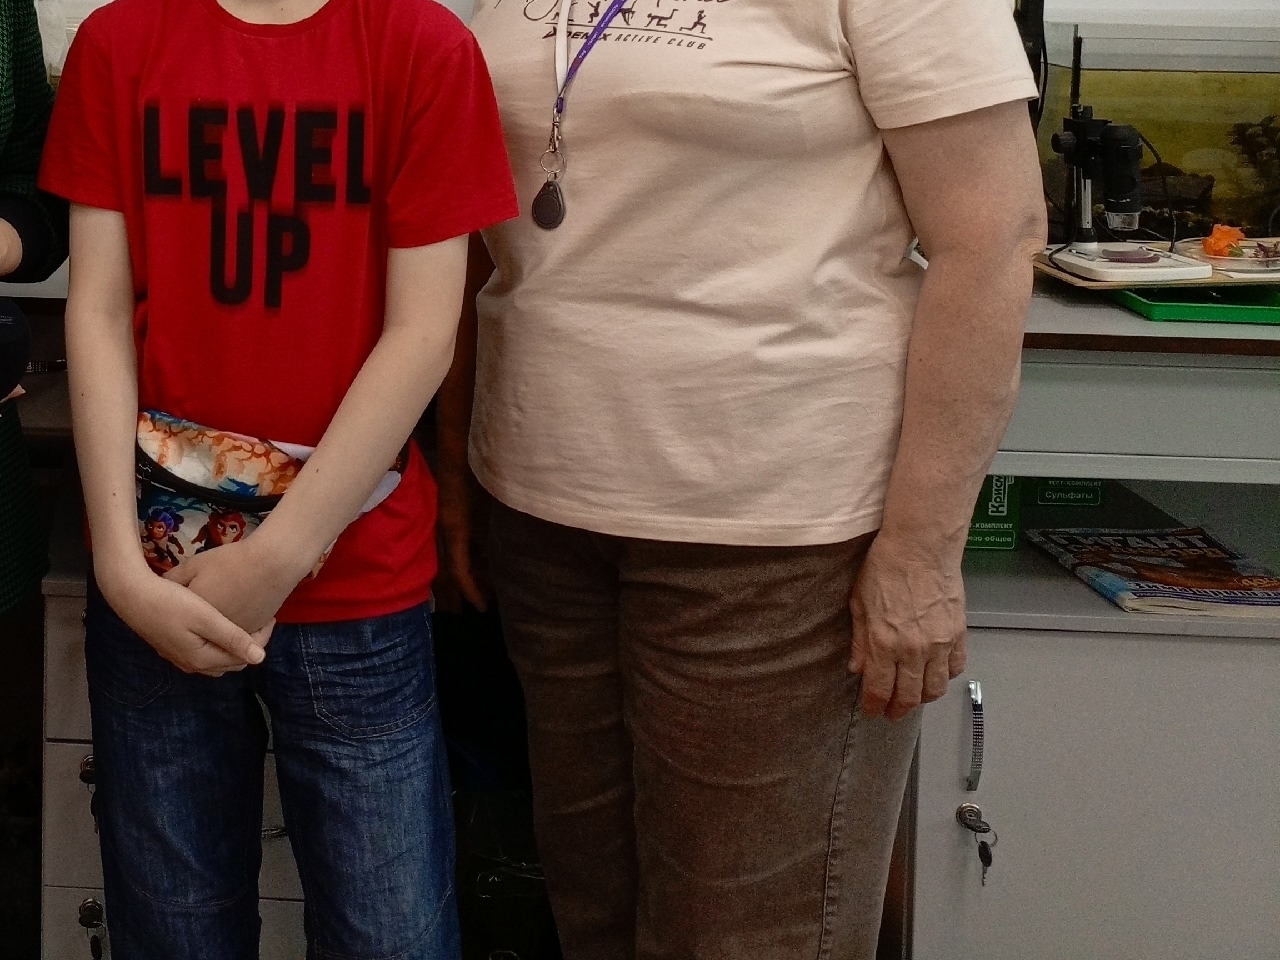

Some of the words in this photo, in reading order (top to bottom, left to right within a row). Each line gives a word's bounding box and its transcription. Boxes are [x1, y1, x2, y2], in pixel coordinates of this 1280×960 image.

[614, 33, 662, 44] ACTIVE
[667, 37, 707, 50] CLUB
[143, 105, 371, 205] LEVEL
[210, 208, 312, 310] UP
[1045, 490, 1094, 500] Сульфаты
[984, 534, 1012, 543] общее
[1048, 534, 1208, 548] ГИГАНТ
